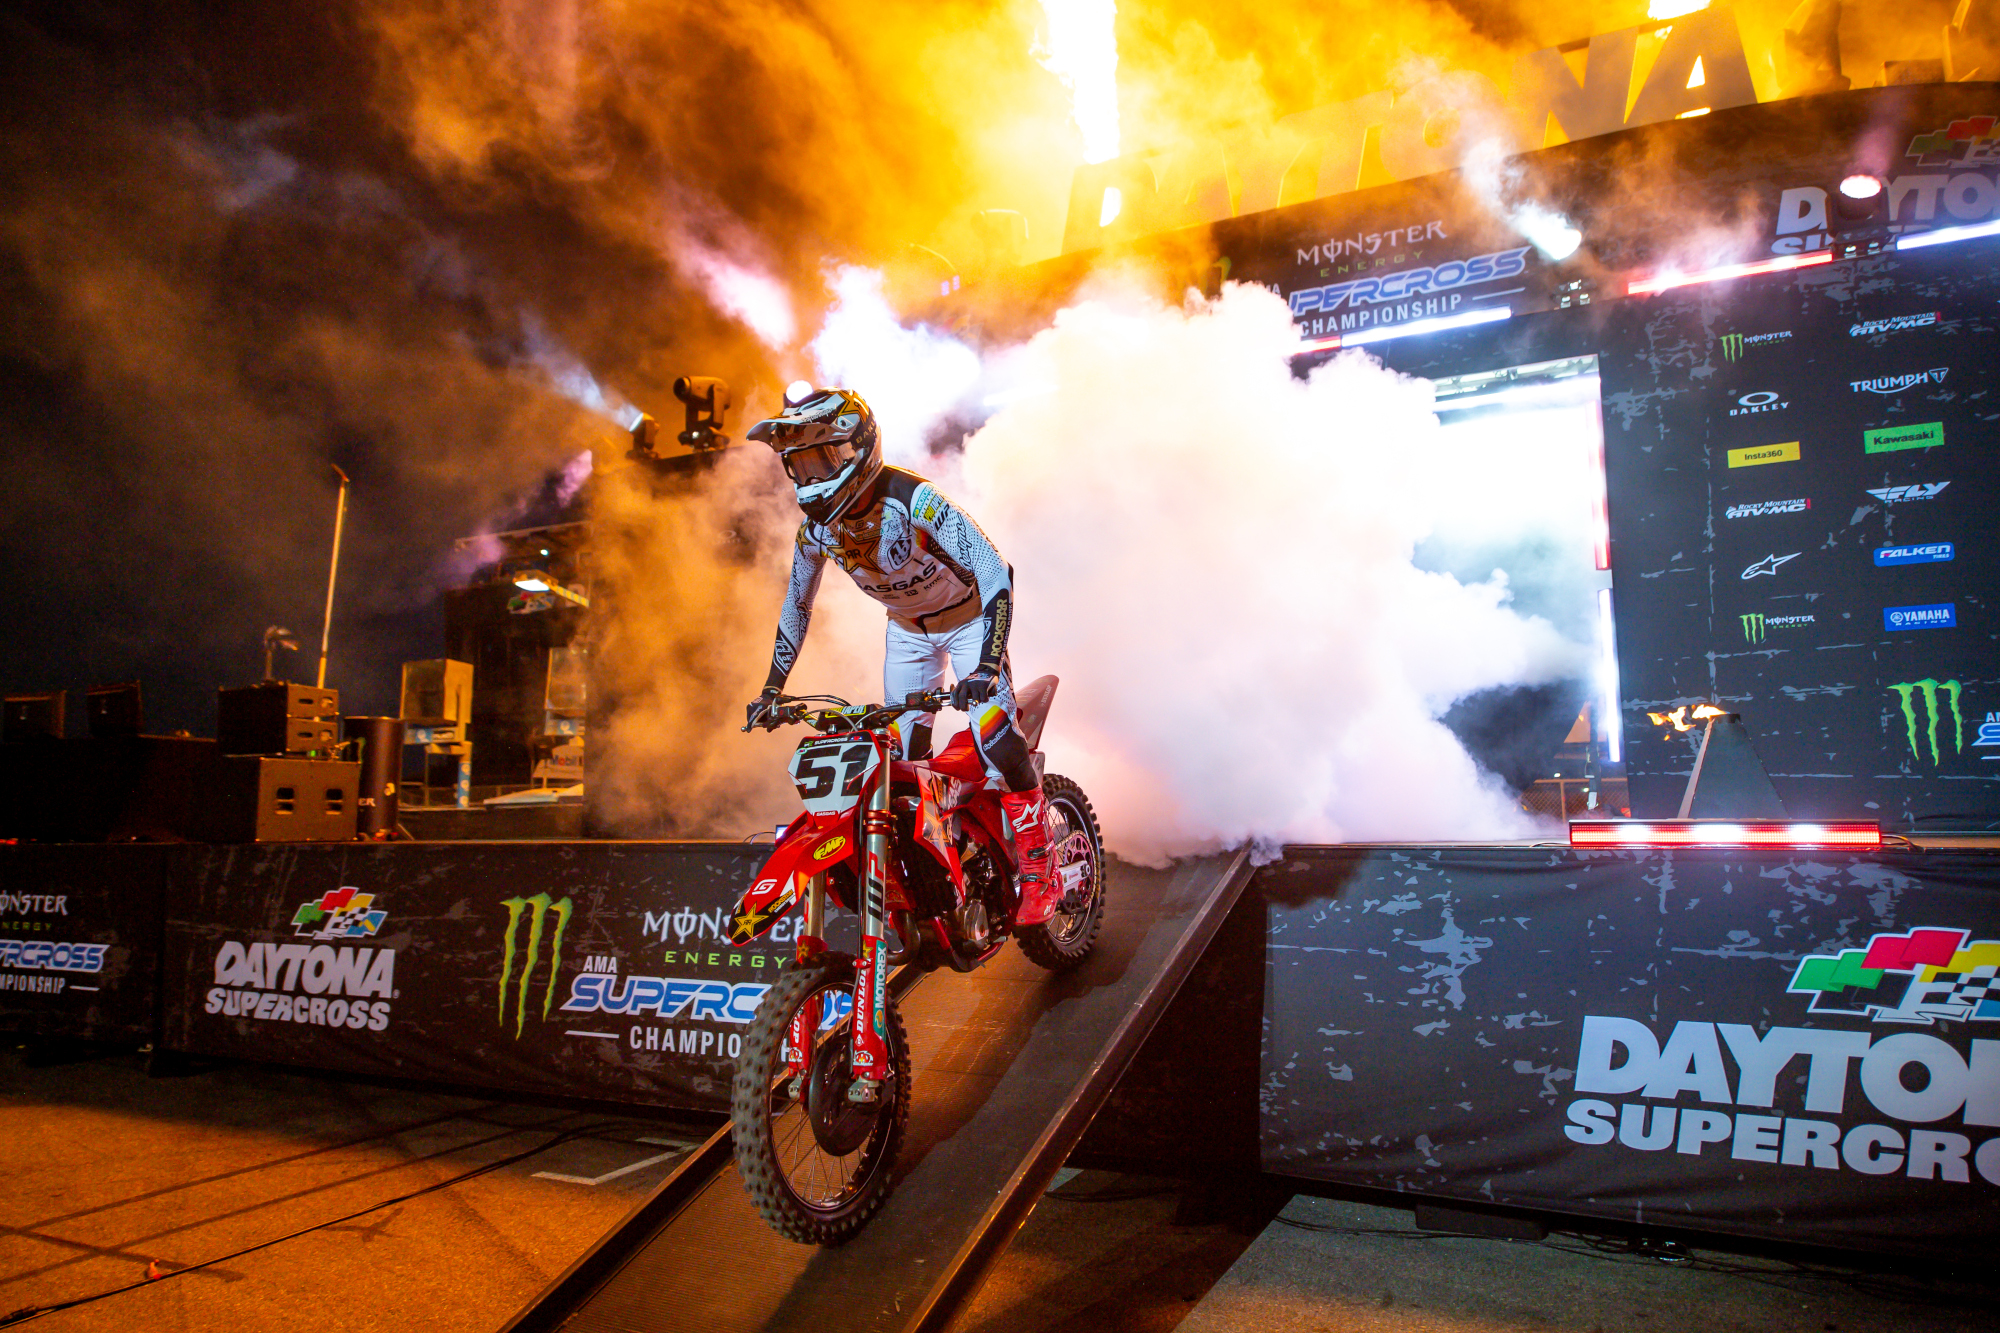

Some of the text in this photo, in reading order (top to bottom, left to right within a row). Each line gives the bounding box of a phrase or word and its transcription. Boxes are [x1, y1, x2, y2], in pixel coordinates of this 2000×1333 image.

[1776, 172, 2000, 235] DYTO
[1297, 220, 1449, 267] MONSTER
[1321, 251, 1423, 278] ENERGY
[1289, 246, 1532, 317] PERCROSS
[1300, 295, 1462, 337] CHAMPIONSHIP
[1744, 330, 1793, 344] MONSTER
[1851, 372, 1928, 393] TRIUMPH
[1729, 402, 1789, 416] OAKLEY
[1873, 431, 1934, 445] Kawasaki
[1744, 450, 1783, 461] Insta360
[1866, 481, 1951, 500] FLY
[1879, 545, 1951, 558] FALKEN
[862, 561, 937, 593] ASGAS
[991, 599, 1007, 657] ROCKSTAR
[1765, 615, 1815, 626] MONSTER
[1903, 609, 1950, 622] YAMAHA
[813, 836, 845, 860] FMF
[0, 889, 68, 916] ONSTER
[2, 921, 52, 931] NERGY
[642, 906, 805, 945] MONE
[0, 939, 110, 973] RCROSS
[214, 940, 396, 999] DAYTONA
[583, 955, 618, 974] AMA
[664, 950, 788, 969] ENERGY
[875, 947, 887, 1009] MOTOREX
[205, 987, 391, 1031] SUPERCROSS
[857, 966, 867, 1033] DUNLO
